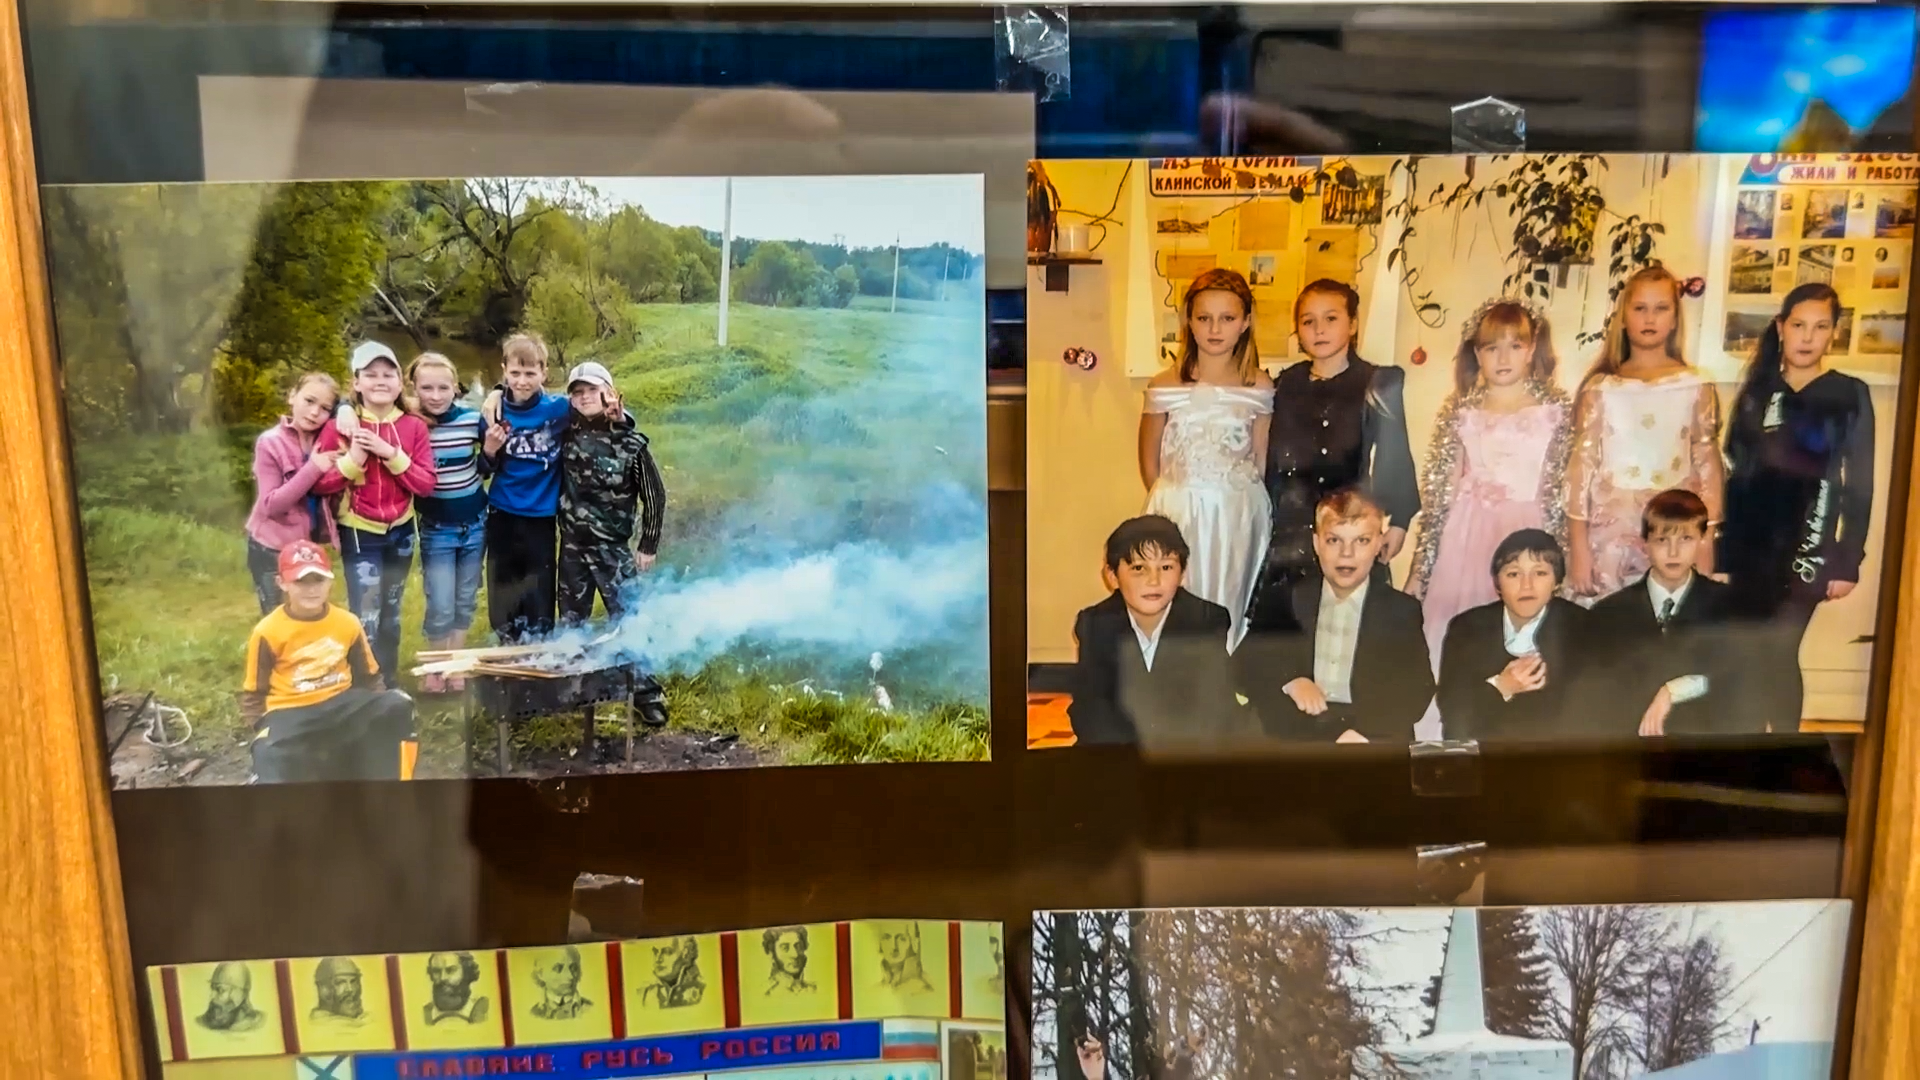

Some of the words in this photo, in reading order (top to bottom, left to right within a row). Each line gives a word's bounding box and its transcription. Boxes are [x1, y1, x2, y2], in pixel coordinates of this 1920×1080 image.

[1155, 173, 1232, 190] КЛИНСКОЙ
[1790, 166, 1836, 180] ЖИЛИ
[1847, 166, 1857, 180] И
[580, 1046, 674, 1070] РУСЬ
[702, 1031, 841, 1060] РОССИЯ
